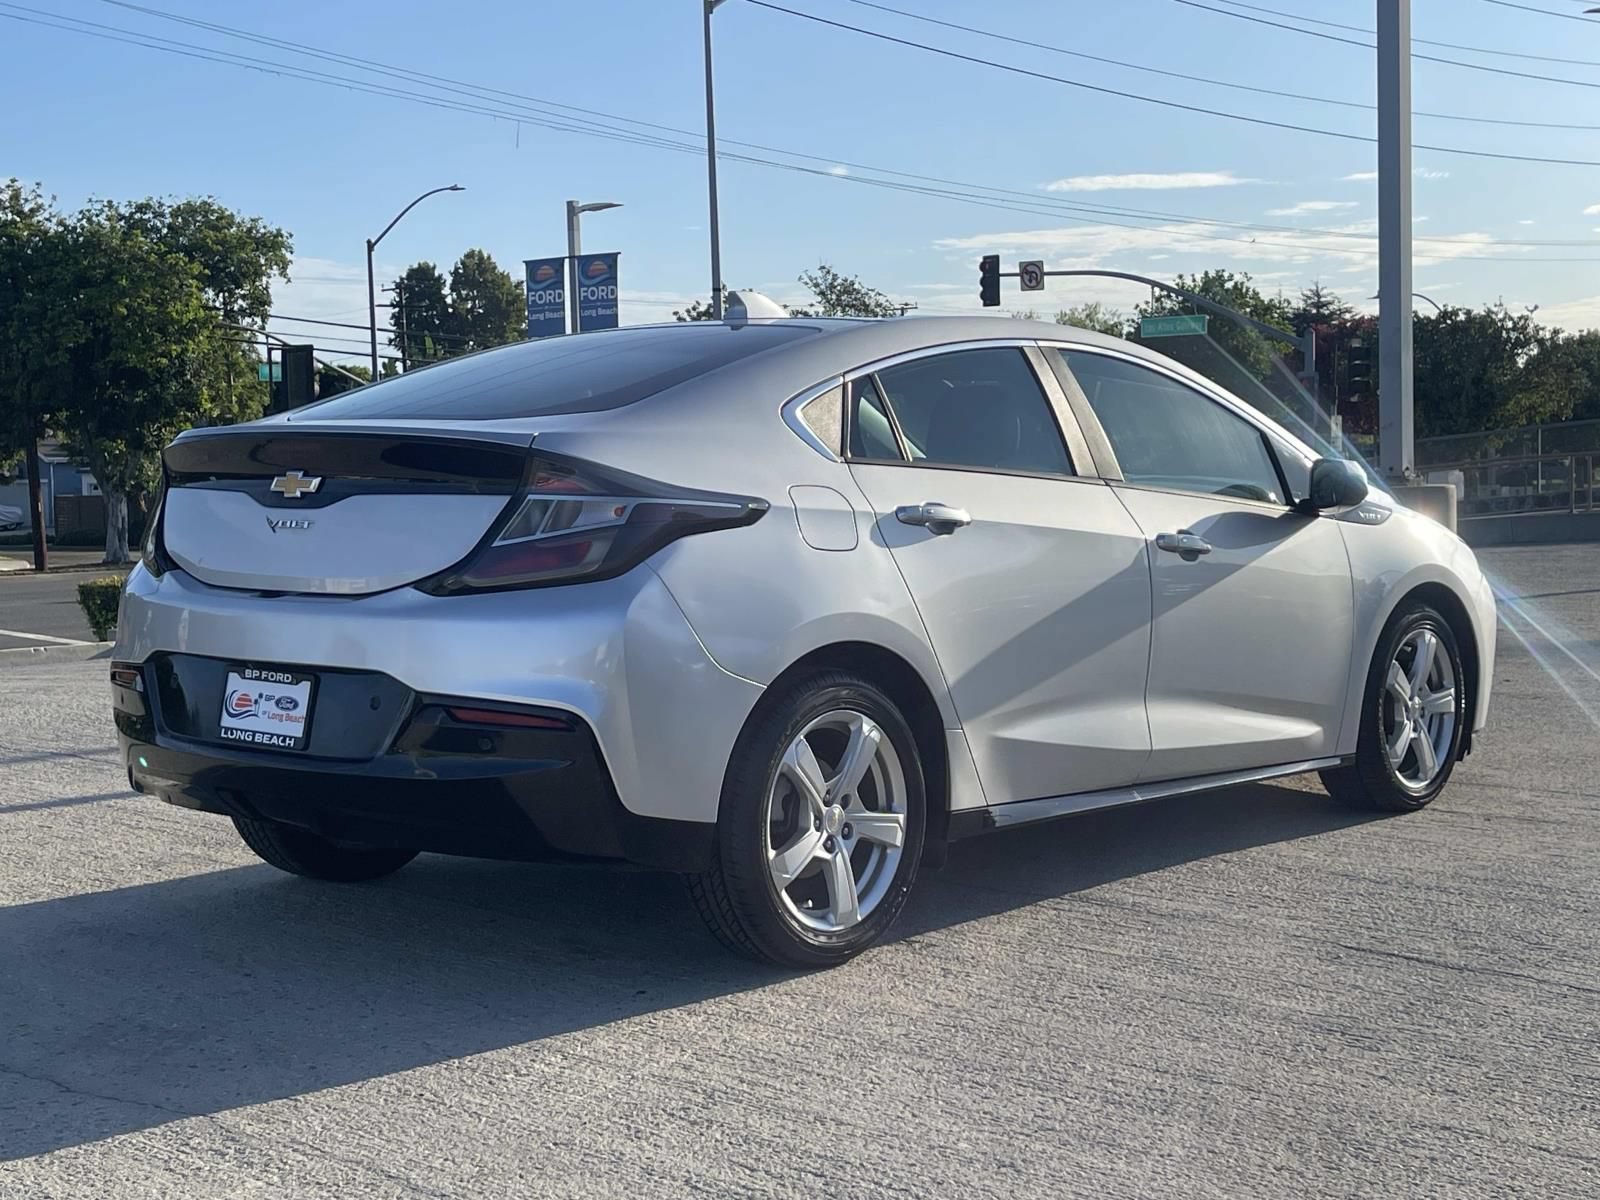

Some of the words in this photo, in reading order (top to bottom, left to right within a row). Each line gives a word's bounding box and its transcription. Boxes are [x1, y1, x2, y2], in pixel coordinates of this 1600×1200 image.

[528, 290, 564, 305] FORD
[580, 286, 617, 301] FORD
[580, 309, 597, 317] Long
[244, 669, 260, 679] BP
[261, 671, 292, 683] FORD
[267, 711, 284, 722] Long
[254, 733, 295, 747] BEACH
